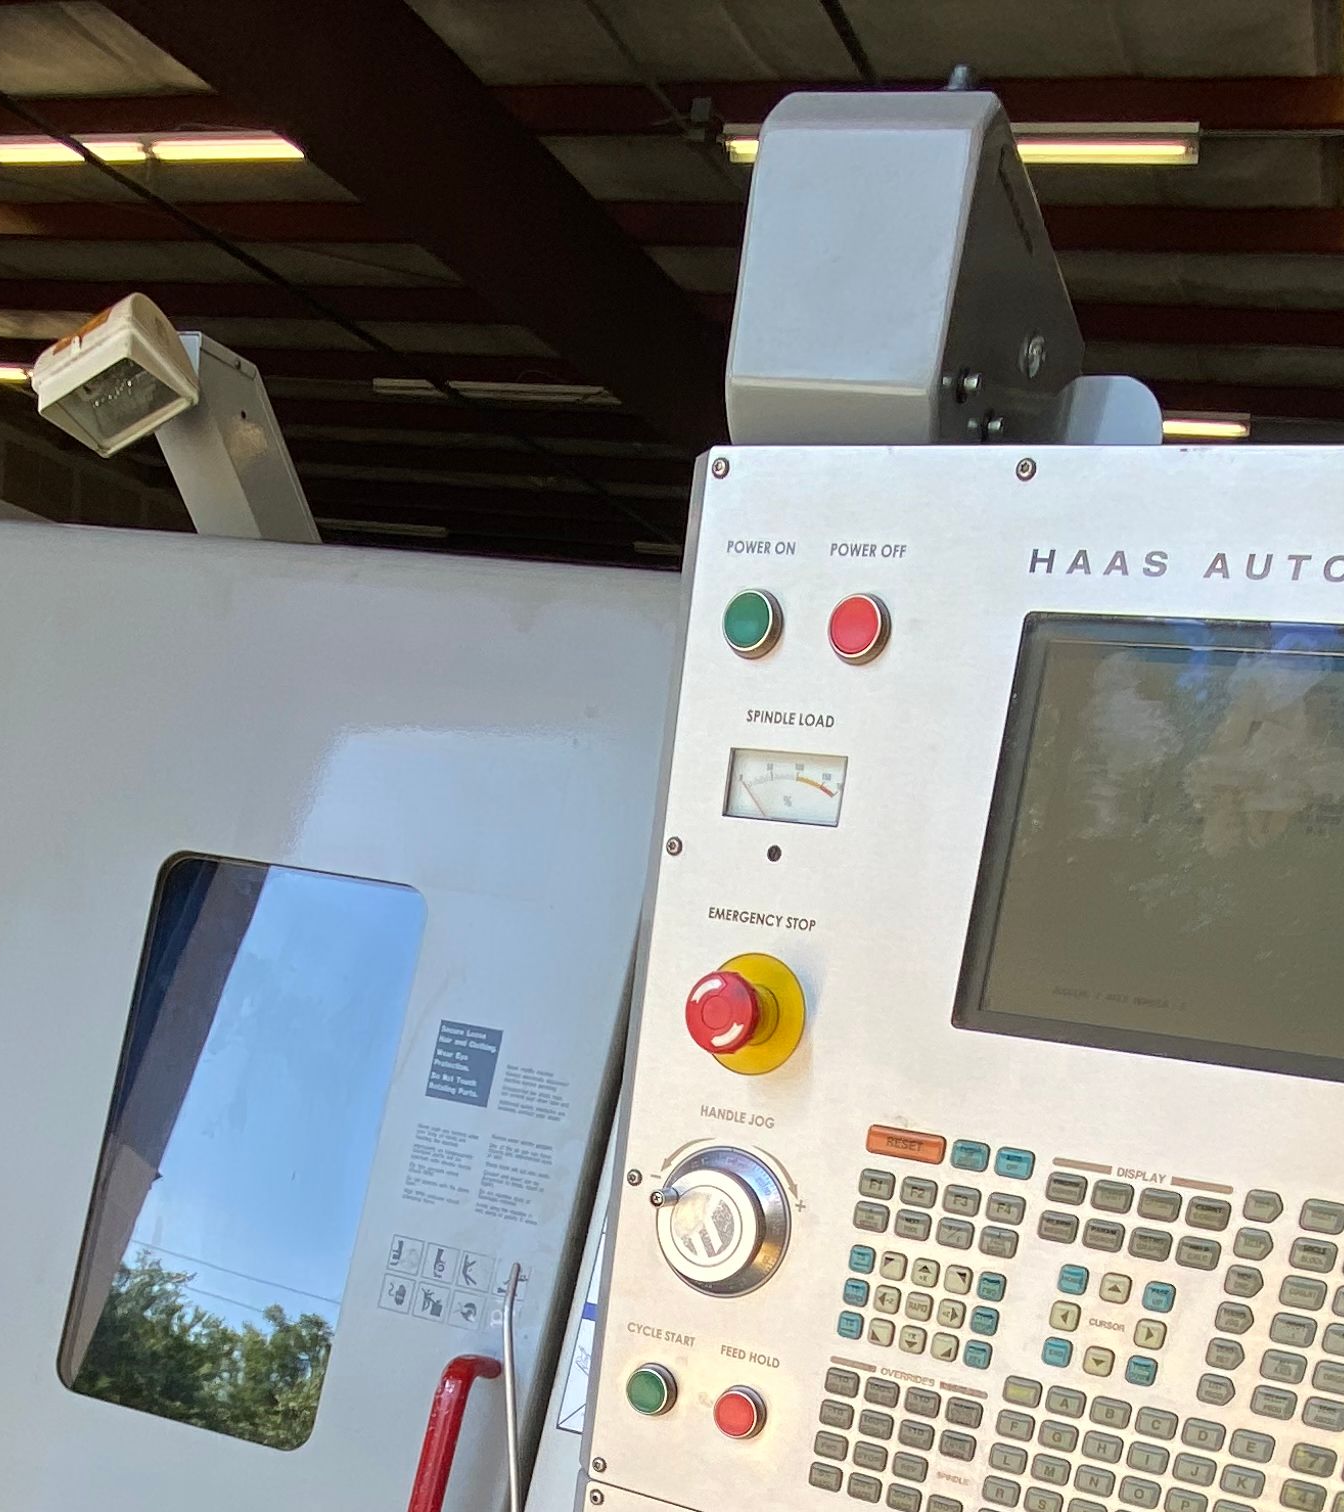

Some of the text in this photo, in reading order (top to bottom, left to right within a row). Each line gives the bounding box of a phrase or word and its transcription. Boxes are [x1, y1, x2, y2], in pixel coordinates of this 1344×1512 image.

[726, 541, 796, 555] POWER ON
[830, 543, 906, 558] POWER OFF
[1028, 549, 1169, 578] HAAS
[747, 710, 834, 728] SPINDLE LOAD
[708, 907, 815, 931] EMERGENCY STOP
[454, 1039, 467, 1047] and
[437, 1049, 453, 1058] Wear
[431, 1072, 477, 1087] Do Not Touch
[700, 1105, 775, 1129] HANDLE JOG
[886, 1135, 924, 1151] RESET
[1117, 1167, 1167, 1184] DISPLAY
[869, 1180, 882, 1190] F1
[910, 1185, 924, 1198] F2
[953, 1194, 968, 1206] F3
[996, 1203, 1011, 1214] F4
[1089, 1318, 1125, 1333] CURSOR
[627, 1322, 696, 1348] CYCLE START
[720, 1344, 780, 1368] FEED HOLD
[881, 1367, 935, 1387] OVERRIDES
[1059, 1397, 1070, 1409] A
[1105, 1408, 1114, 1419] B
[1010, 1421, 1019, 1432] F
[1151, 1419, 1161, 1431] C
[1198, 1430, 1208, 1441] D
[1096, 1442, 1107, 1454] H
[1246, 1441, 1256, 1453] E
[1002, 1454, 1010, 1465] L
[1308, 1456, 1318, 1469] 7
[1044, 1465, 1056, 1477] M
[1190, 1465, 1199, 1477] J
[1089, 1476, 1099, 1488] N
[1236, 1476, 1248, 1489] K
[994, 1487, 1005, 1499] R
[1133, 1487, 1144, 1499] O
[1038, 1498, 1047, 1510] S
[1181, 1500, 1191, 1511] P
